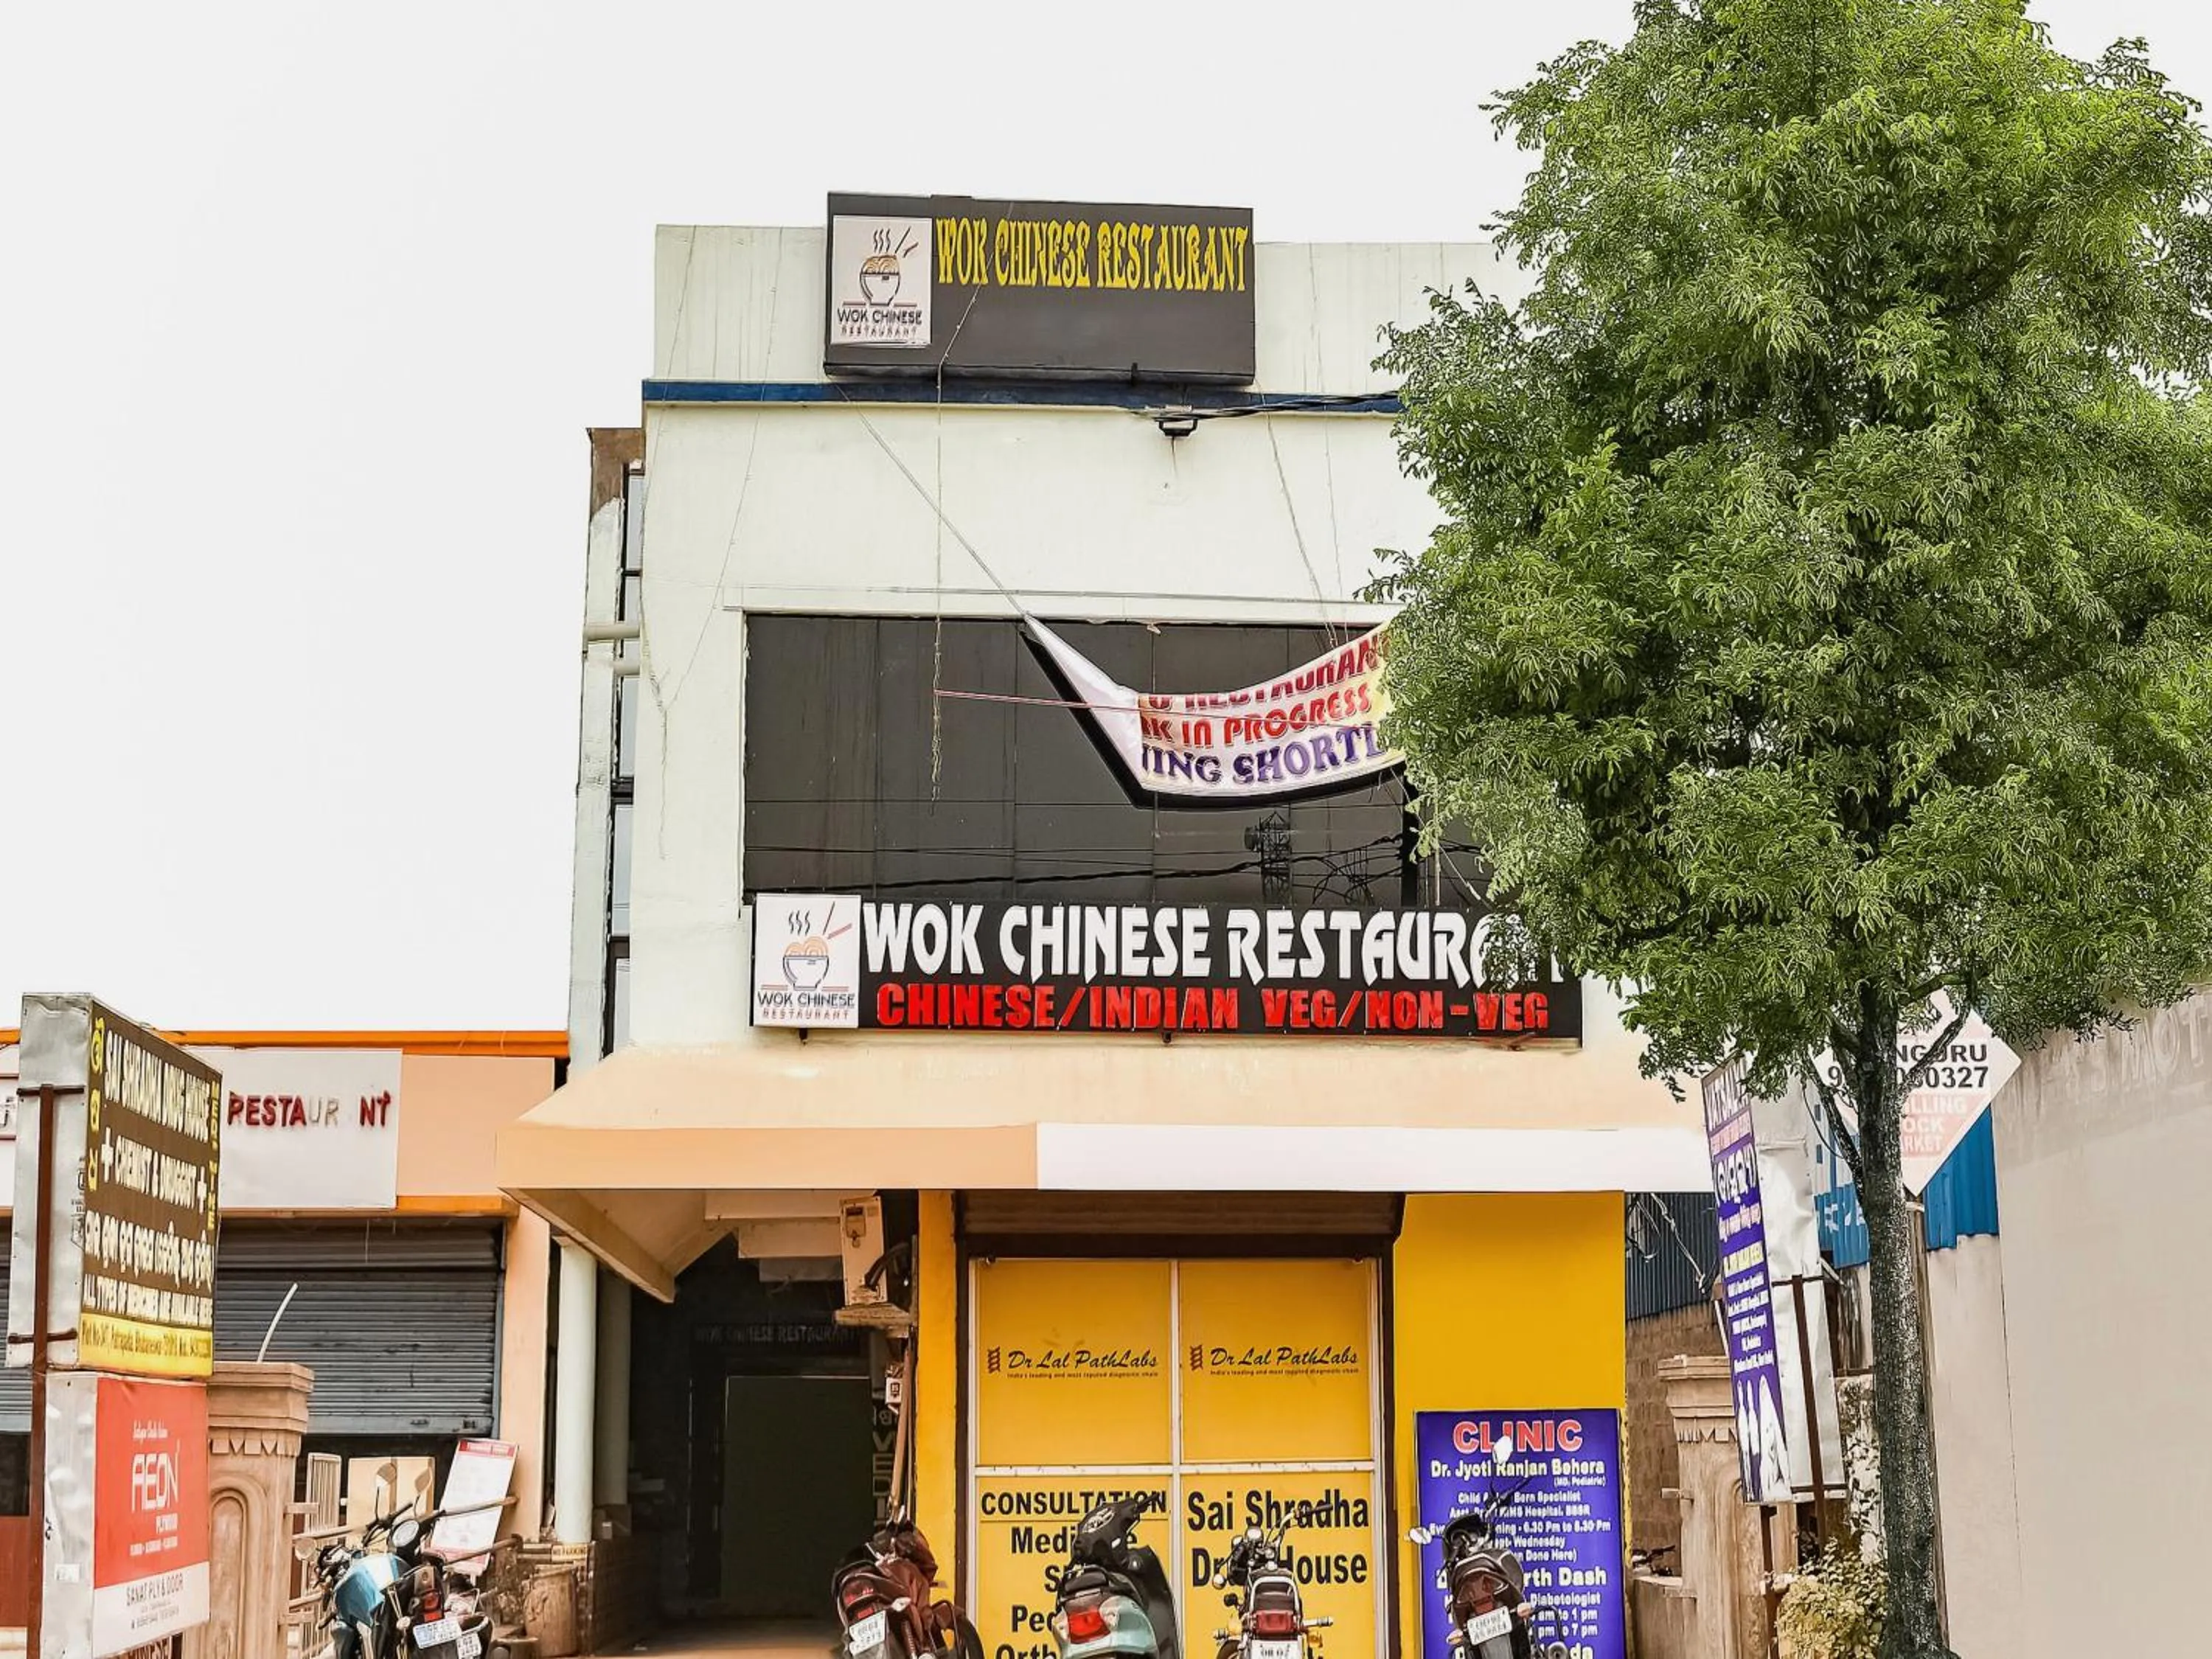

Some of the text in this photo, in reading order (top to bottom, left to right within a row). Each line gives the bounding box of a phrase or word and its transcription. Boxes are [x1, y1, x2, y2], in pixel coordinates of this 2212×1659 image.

[936, 218, 1248, 292] WOK CHINESE RESTAURANT
[837, 307, 922, 324] WOK CHINESE
[1182, 720, 1212, 747] IN
[1224, 682, 1371, 746] PROGRESS
[1233, 721, 1385, 783] SHORTL
[863, 902, 1564, 988] WOK CHINESE RESTAUR
[758, 991, 855, 1008] WOK CHINESE
[877, 984, 1549, 1031] CHINESE/INDIAN VEG/NON-VEG
[763, 1008, 849, 1020] RESTAURANT
[1903, 1116, 1944, 1133] OCK
[1008, 1349, 1158, 1369] Dr Lal PathLabs
[1210, 1346, 1357, 1366] Dr Lal PathLabs
[1431, 1461, 1452, 1478] Dr.
[1455, 1460, 1492, 1481] Jyoti
[1496, 1459, 1547, 1478] Ranjan
[1458, 1492, 1481, 1504] Child
[1514, 1491, 1535, 1503] Born
[1537, 1490, 1581, 1504] Specialist
[1188, 1489, 1369, 1531] Sai Shradha
[1545, 1520, 1561, 1532] Pm
[1562, 1520, 1572, 1533] to
[1596, 1519, 1611, 1531] Pm
[1012, 1526, 1138, 1554] Medie
[1513, 1535, 1565, 1549] Wednesday
[1526, 1550, 1549, 1562] Done
[1551, 1548, 1576, 1562] Here)
[1559, 1566, 1607, 1587] Dash
[1530, 1591, 1601, 1607] Diabetologist
[1538, 1610, 1555, 1621] am
[1581, 1610, 1598, 1623] pm
[1538, 1626, 1555, 1640] pm
[1571, 1624, 1579, 1636] 7
[1581, 1624, 1598, 1638] pm
